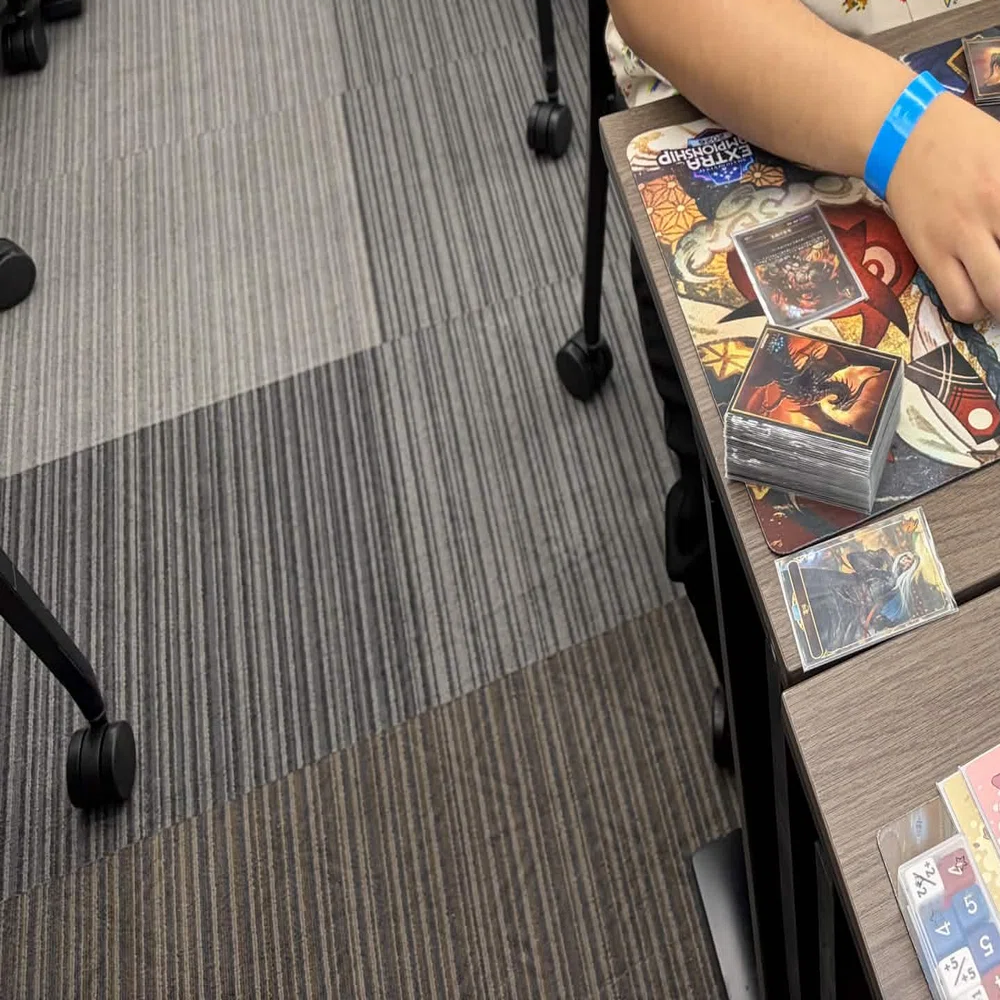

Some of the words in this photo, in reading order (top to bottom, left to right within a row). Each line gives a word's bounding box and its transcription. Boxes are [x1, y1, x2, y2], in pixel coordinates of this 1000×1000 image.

[687, 144, 752, 171] EXTRA
[963, 894, 978, 915] 5
[935, 920, 951, 936] 4
[980, 935, 994, 957] 5
